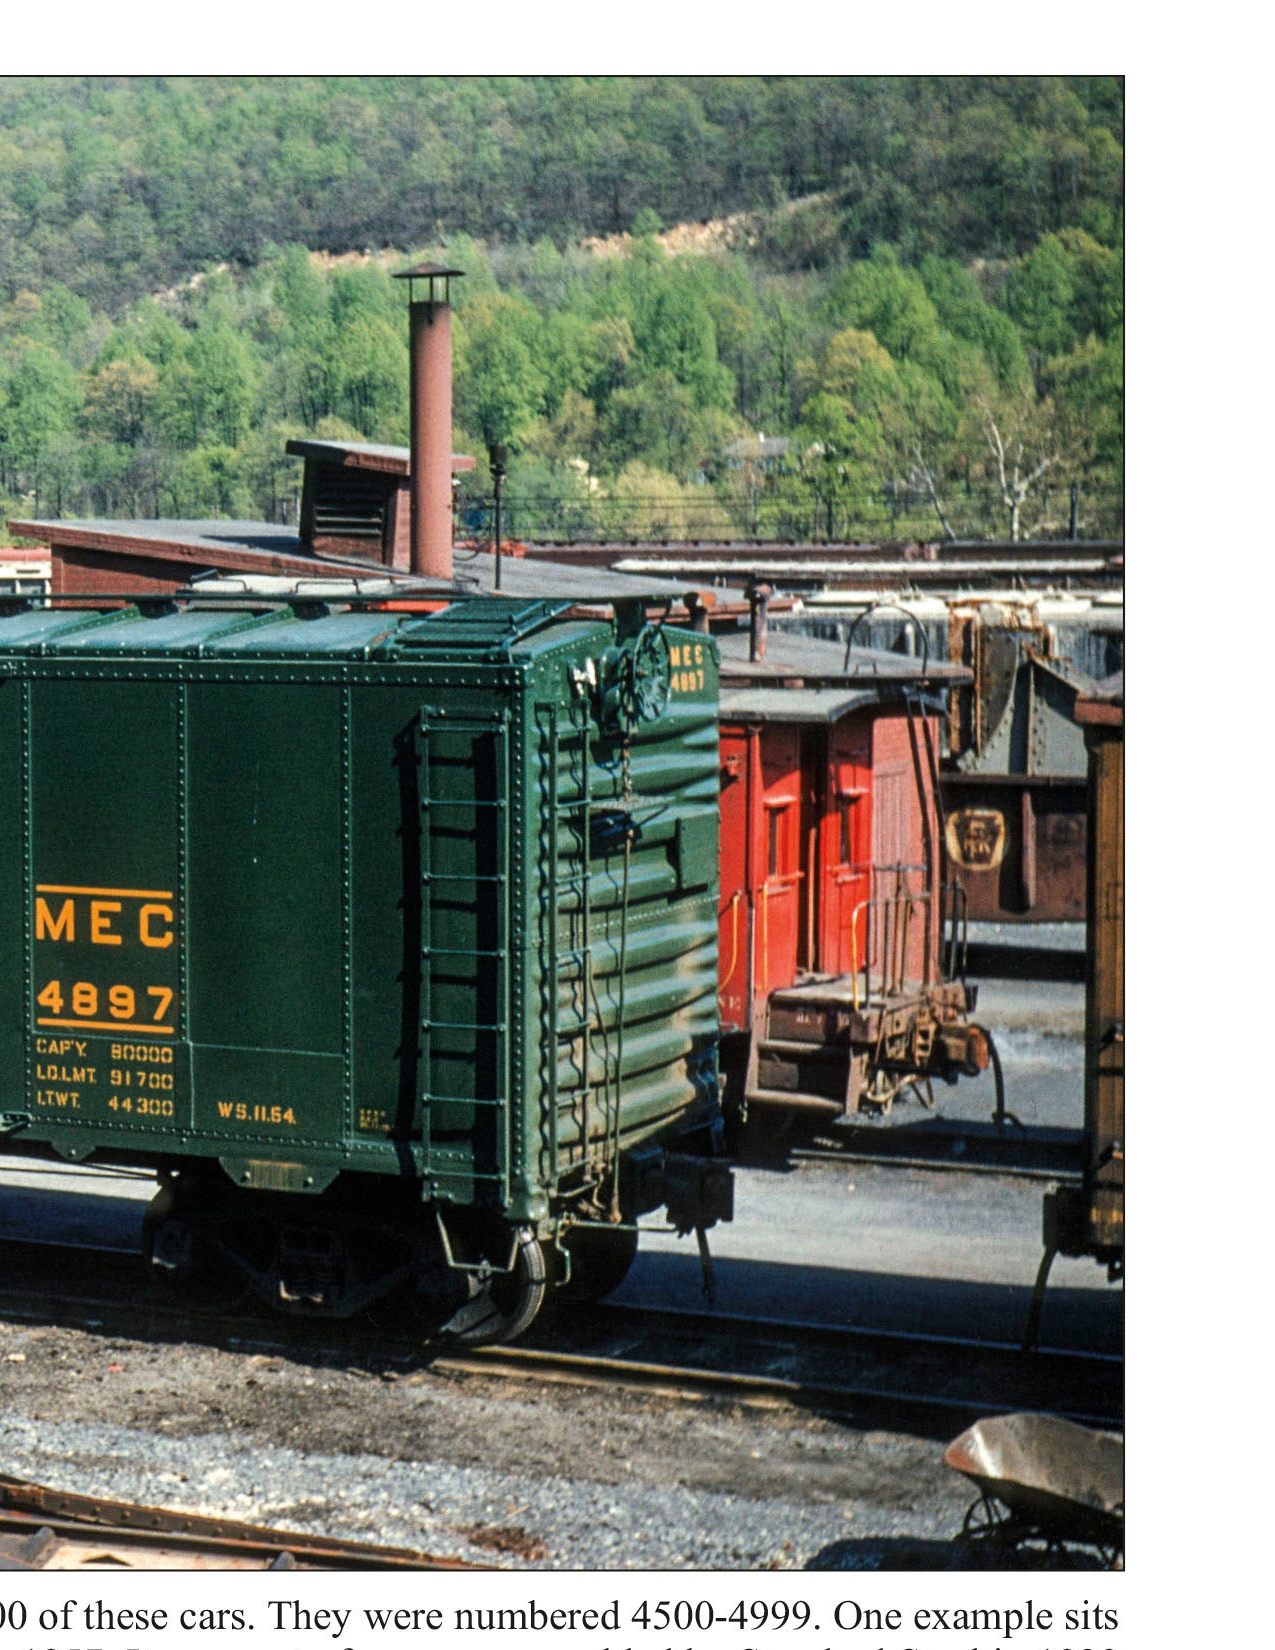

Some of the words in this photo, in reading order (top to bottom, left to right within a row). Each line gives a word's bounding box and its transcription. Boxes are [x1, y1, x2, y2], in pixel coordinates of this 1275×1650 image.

[36, 898, 174, 948] MEC
[37, 980, 174, 1021] 4897
[110, 1043, 174, 1064] 80000
[110, 1069, 174, 1091] 91700
[108, 1095, 174, 1117] 44300
